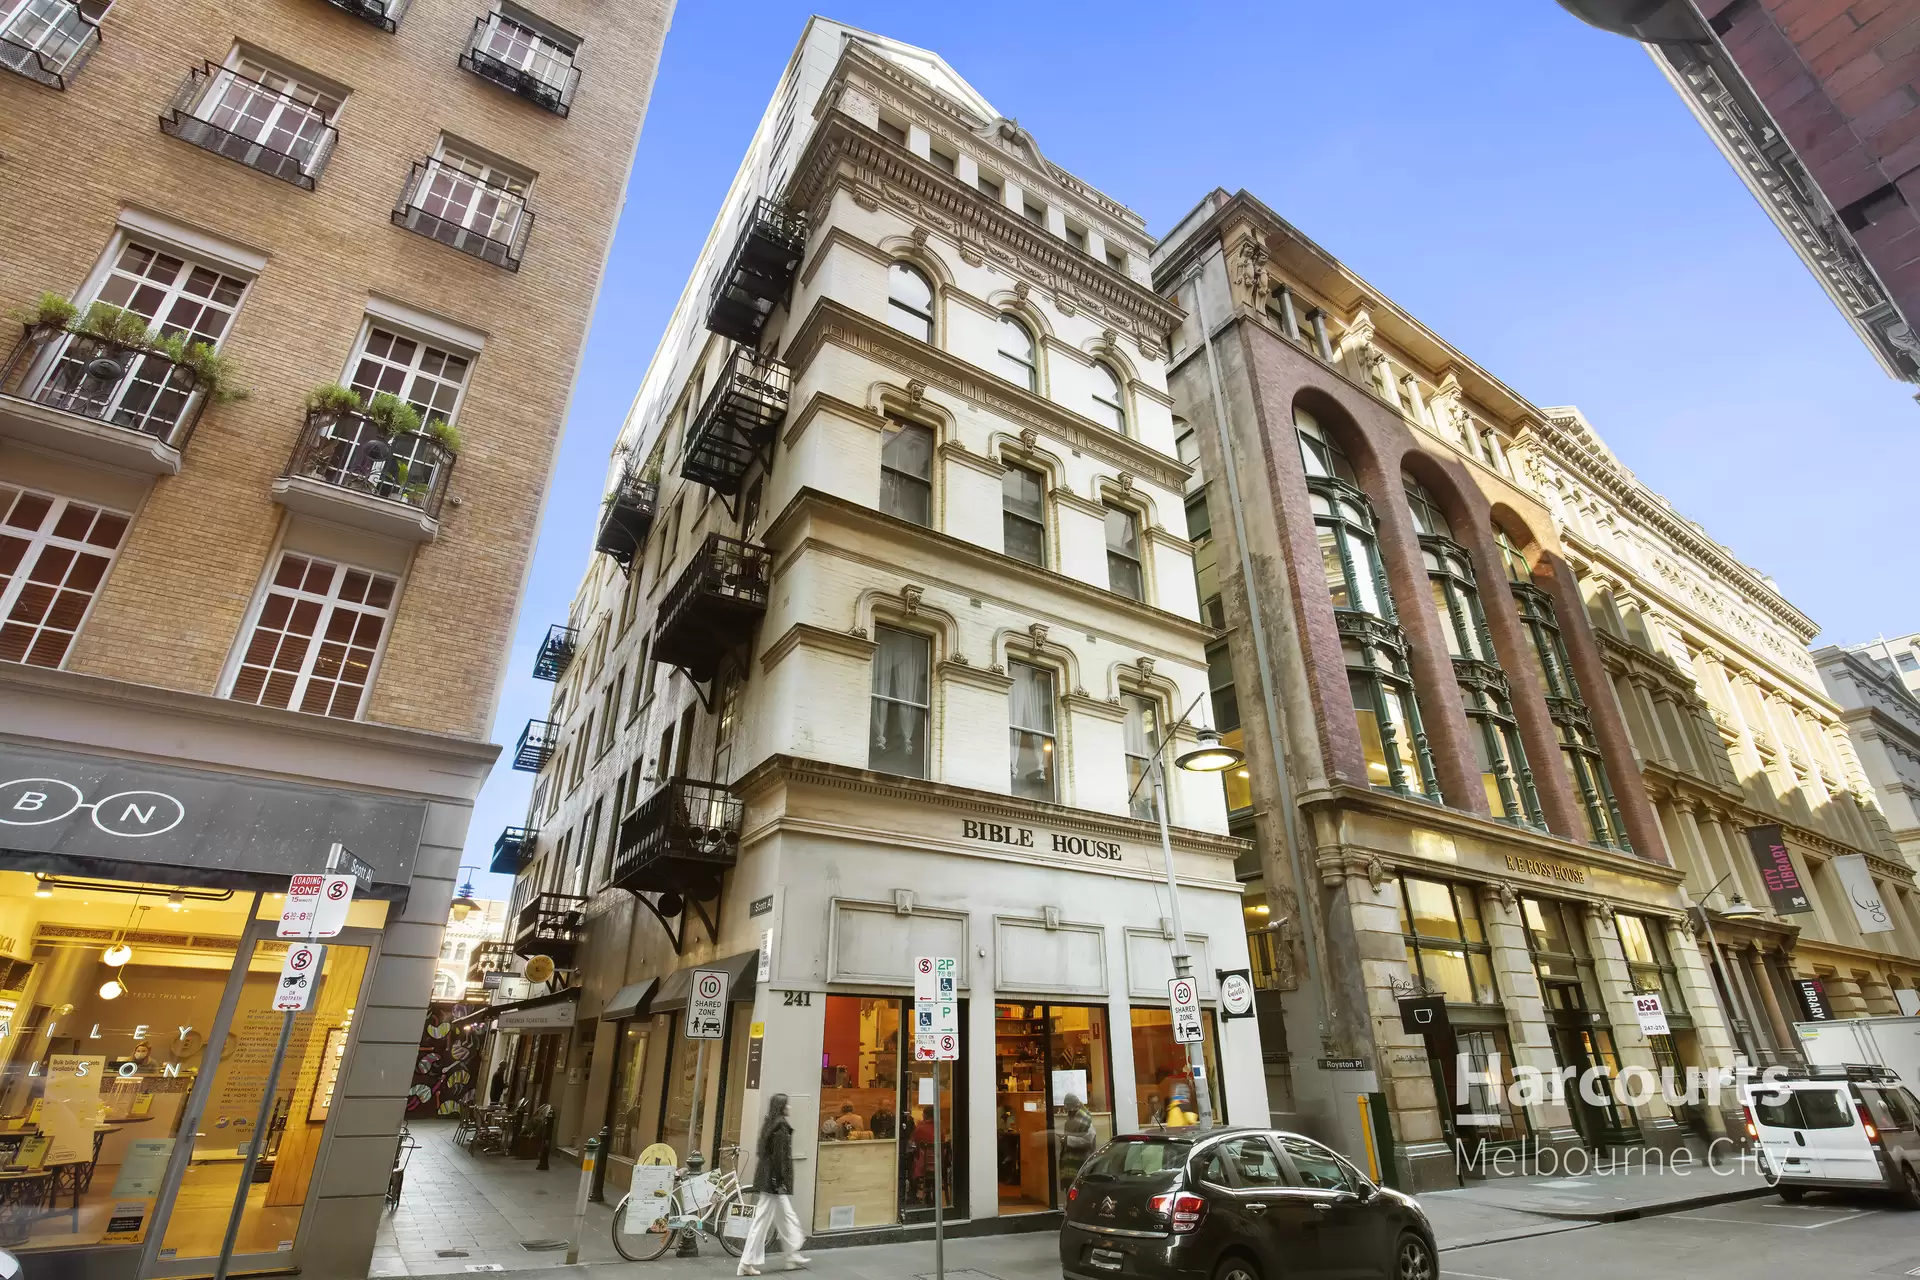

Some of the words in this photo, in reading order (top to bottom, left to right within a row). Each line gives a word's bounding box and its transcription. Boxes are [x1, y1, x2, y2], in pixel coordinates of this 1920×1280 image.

[13, 791, 48, 811] B
[119, 803, 157, 824] N
[962, 819, 1034, 848] BIBLE
[1051, 834, 1122, 861] HOUSE
[350, 858, 366, 879] Scott
[1505, 854, 1515, 871] R
[1516, 856, 1526, 872] E
[1526, 859, 1552, 877] ROSS
[1553, 864, 1585, 884] HOUSE
[1769, 844, 1800, 889] LIBRARY
[293, 876, 322, 885] LOADING
[1763, 868, 1784, 891] CITY
[290, 886, 320, 895] ZONE
[754, 901, 767, 912] Scott
[1866, 899, 1887, 922] CAE
[937, 959, 955, 970] 2P
[704, 981, 717, 993] 10
[1178, 988, 1189, 998] 20
[694, 1000, 722, 1008] SHARED
[783, 990, 812, 1007] 241
[1801, 982, 1826, 1020] LIBRARY
[942, 1007, 951, 1018] P
[1175, 1005, 1196, 1013] SHARED
[1326, 1060, 1354, 1069] Royston
